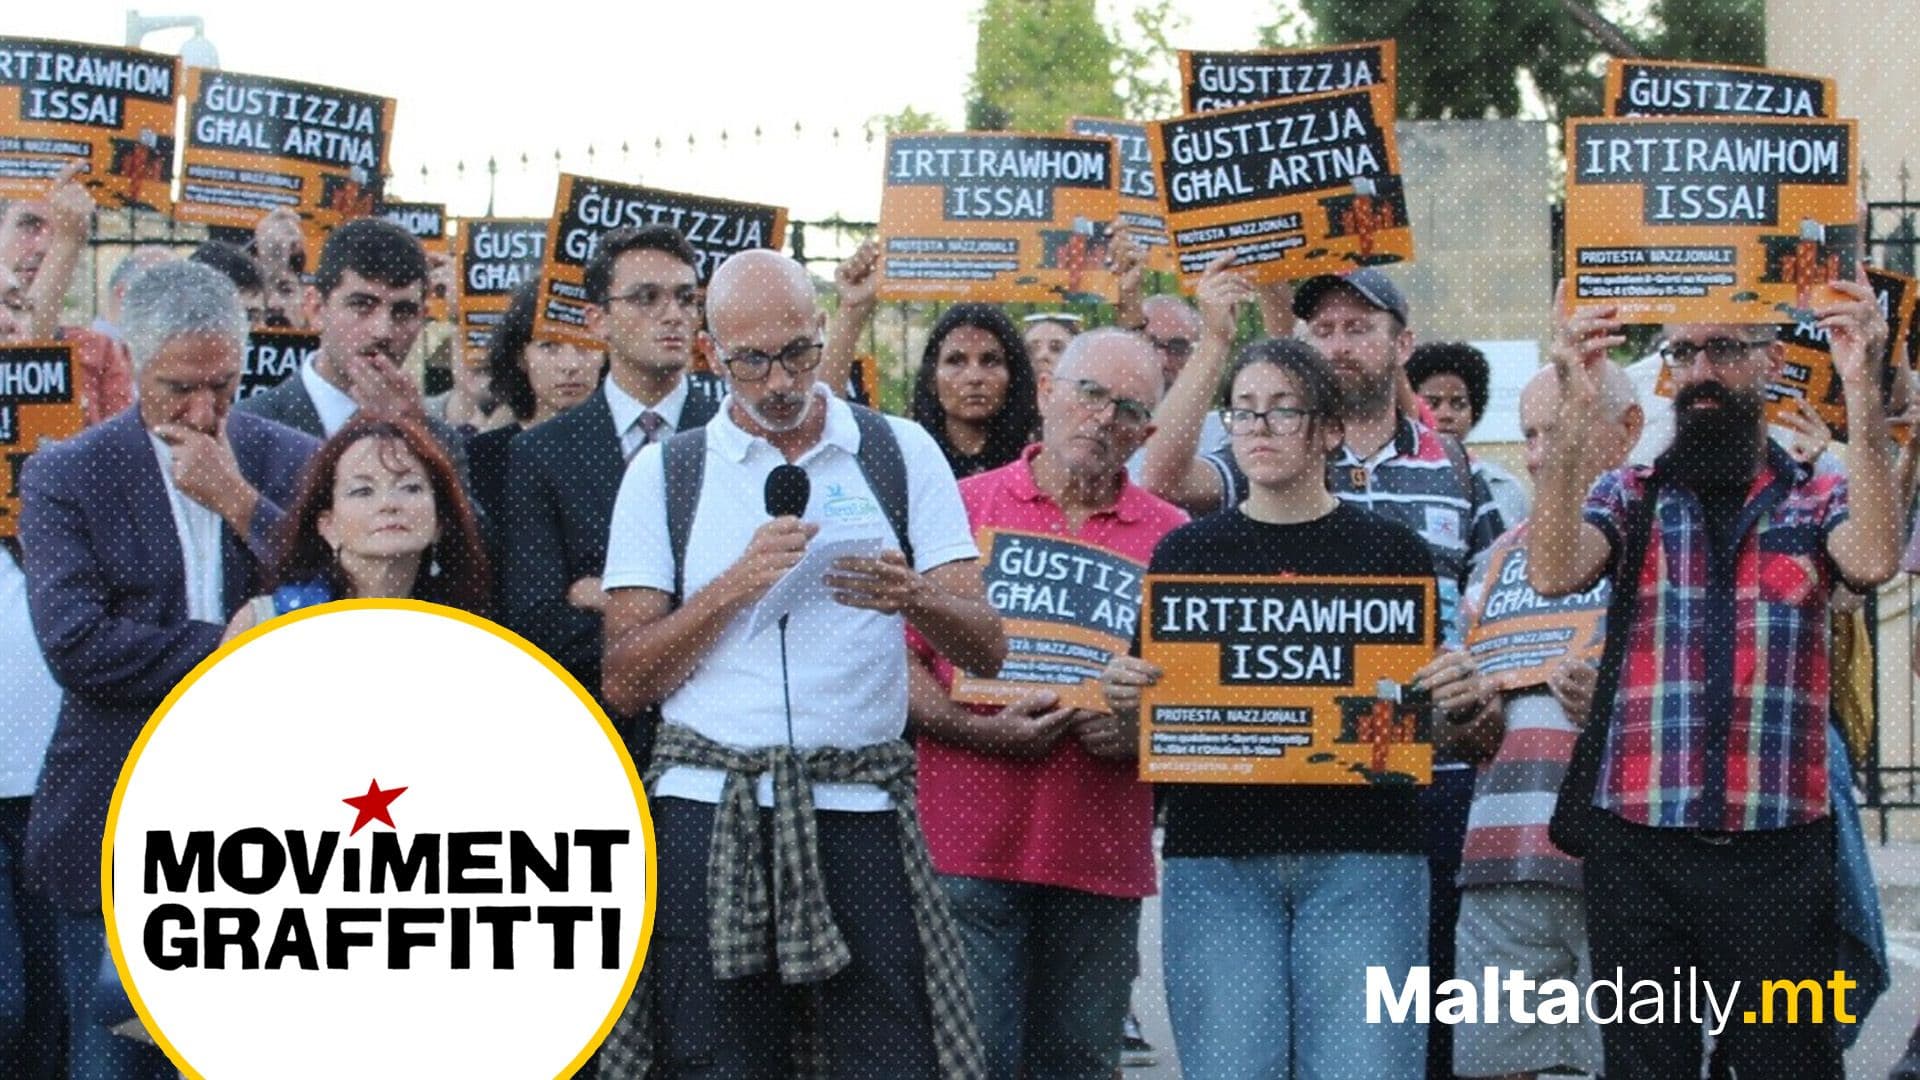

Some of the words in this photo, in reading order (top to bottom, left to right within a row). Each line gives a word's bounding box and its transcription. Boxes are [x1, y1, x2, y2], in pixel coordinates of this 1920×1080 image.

[1200, 58, 1373, 94] ĠUSTIZZJA
[1629, 69, 1814, 116] ĠUSTIZZJA
[29, 88, 118, 125] ISSA!
[206, 78, 375, 134] ĠUSTIZZJA
[283, 126, 375, 167] ARTNA
[1172, 107, 1366, 165] ĠUSTIZZJA
[895, 149, 1104, 181] IRTIRAWHOM
[1267, 144, 1380, 190] ARTNA
[1585, 138, 1839, 174] IRTIRAWHOM
[953, 187, 1044, 216] ISSA!
[1652, 185, 1766, 219] ISSA!
[1580, 250, 1645, 263] PROTESTA
[1650, 250, 1732, 262] NAZZJONALI
[1000, 540, 1140, 602] ĠUSTIZ
[1160, 597, 1416, 634] IRTIRAWHOM
[1231, 645, 1343, 680] ISSA!
[1156, 709, 1221, 722] PROTESTA
[1227, 710, 1307, 722] NAZZJONALI
